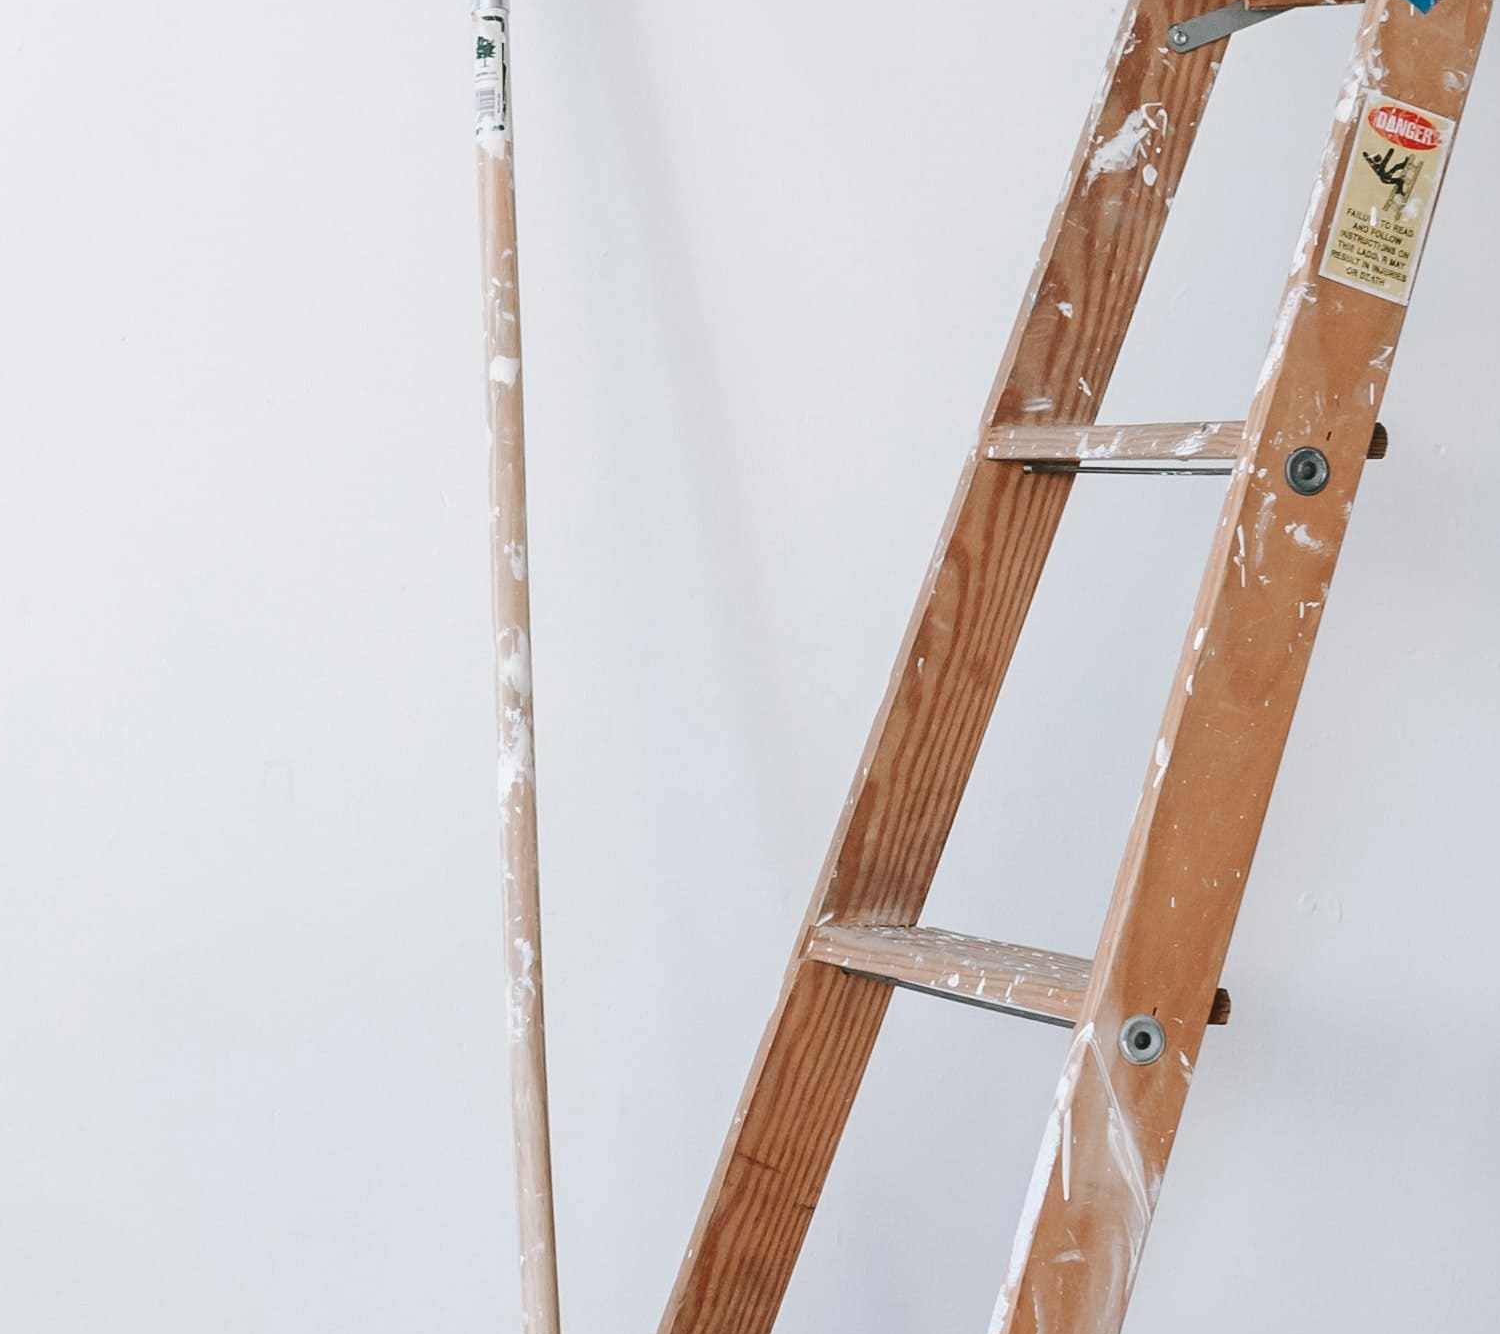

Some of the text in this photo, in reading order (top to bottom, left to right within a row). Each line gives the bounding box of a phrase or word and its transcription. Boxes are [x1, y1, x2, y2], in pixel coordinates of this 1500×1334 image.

[1376, 111, 1433, 145] DANGER
[1352, 222, 1402, 244] AND FOLLOW
[1393, 224, 1414, 237] READ
[1357, 247, 1388, 264] LADDR
